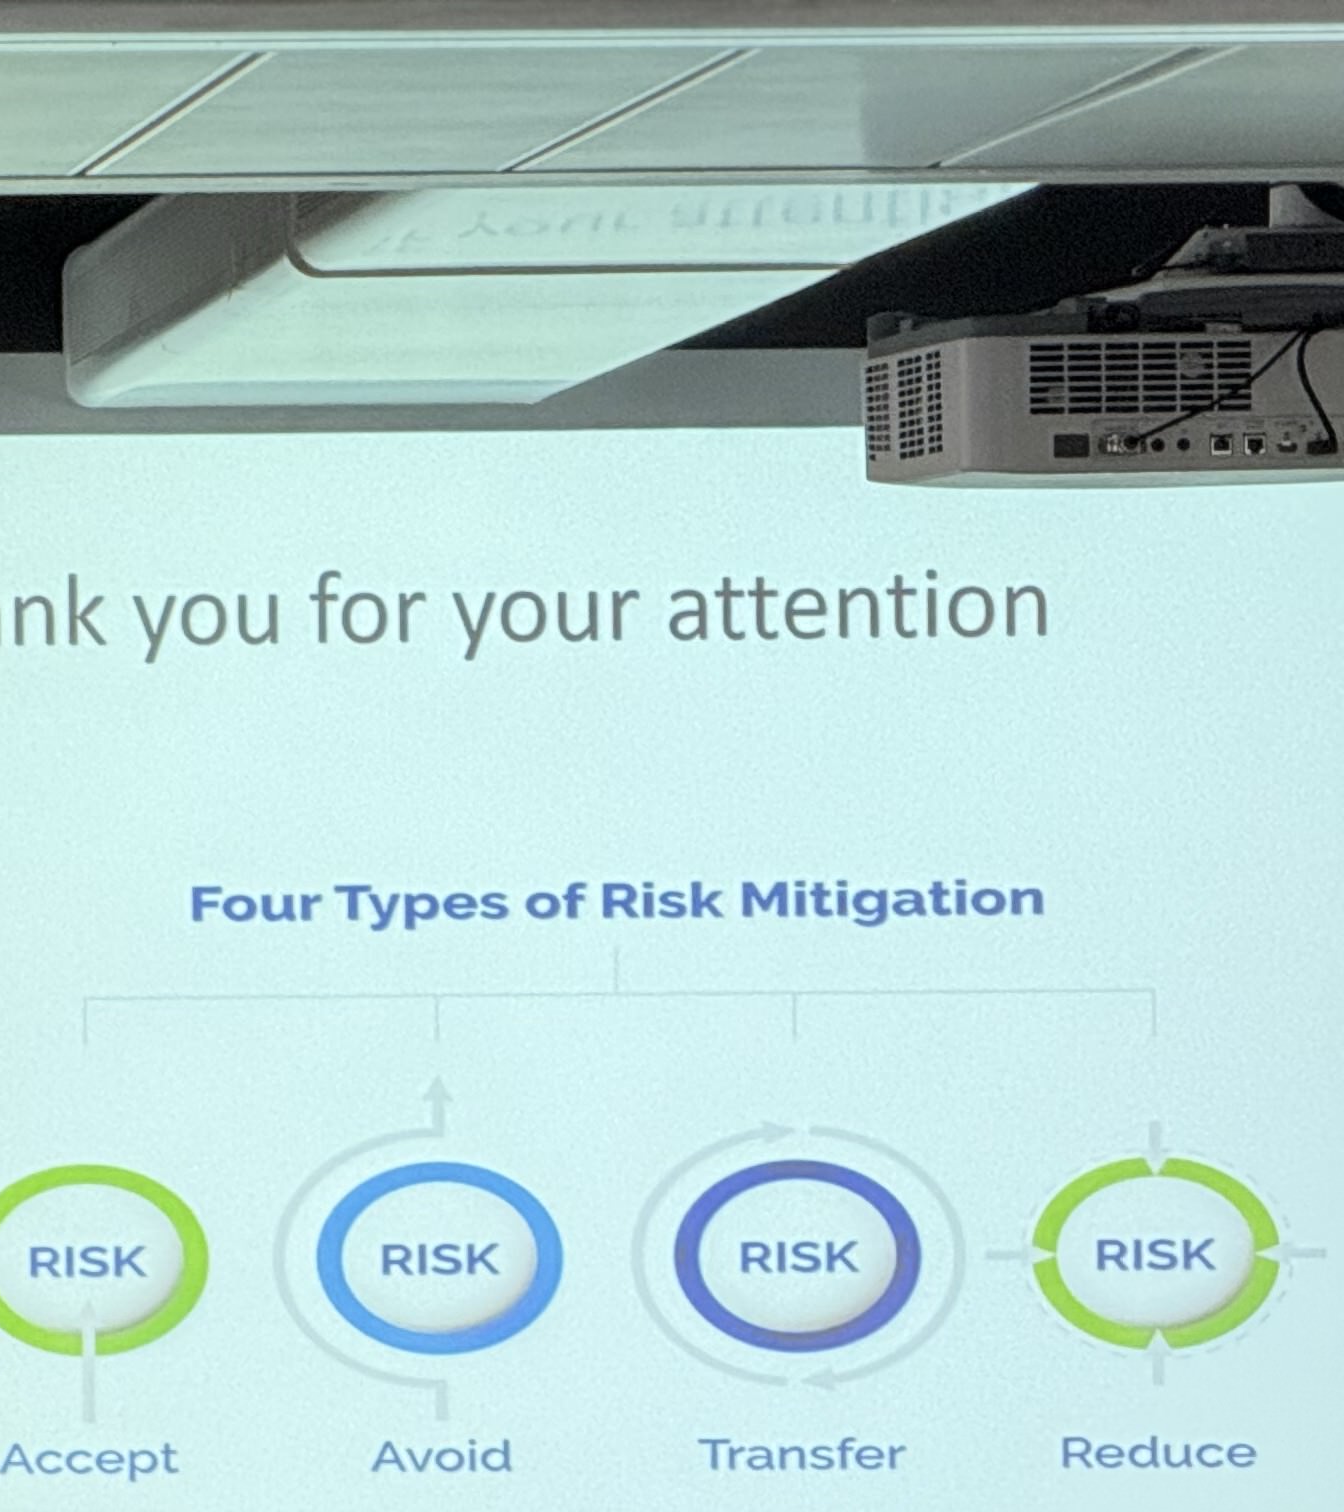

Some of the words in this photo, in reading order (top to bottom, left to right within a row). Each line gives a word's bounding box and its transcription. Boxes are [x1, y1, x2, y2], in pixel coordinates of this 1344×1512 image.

[133, 593, 279, 664] you
[309, 569, 427, 645] for
[452, 589, 641, 662] your
[668, 568, 1050, 642] attention
[191, 884, 324, 923] Four
[333, 883, 510, 932] Types
[524, 880, 588, 921] of
[601, 879, 724, 920] Risk
[741, 877, 1047, 928] Mitigation
[27, 1244, 148, 1279] RISK
[379, 1241, 501, 1277] RISK
[738, 1239, 861, 1275] RISK
[1094, 1237, 1218, 1273] RISK
[370, 1437, 514, 1474] Avoid
[696, 1434, 909, 1472] Transfer
[1060, 1433, 1259, 1470] Reduce
